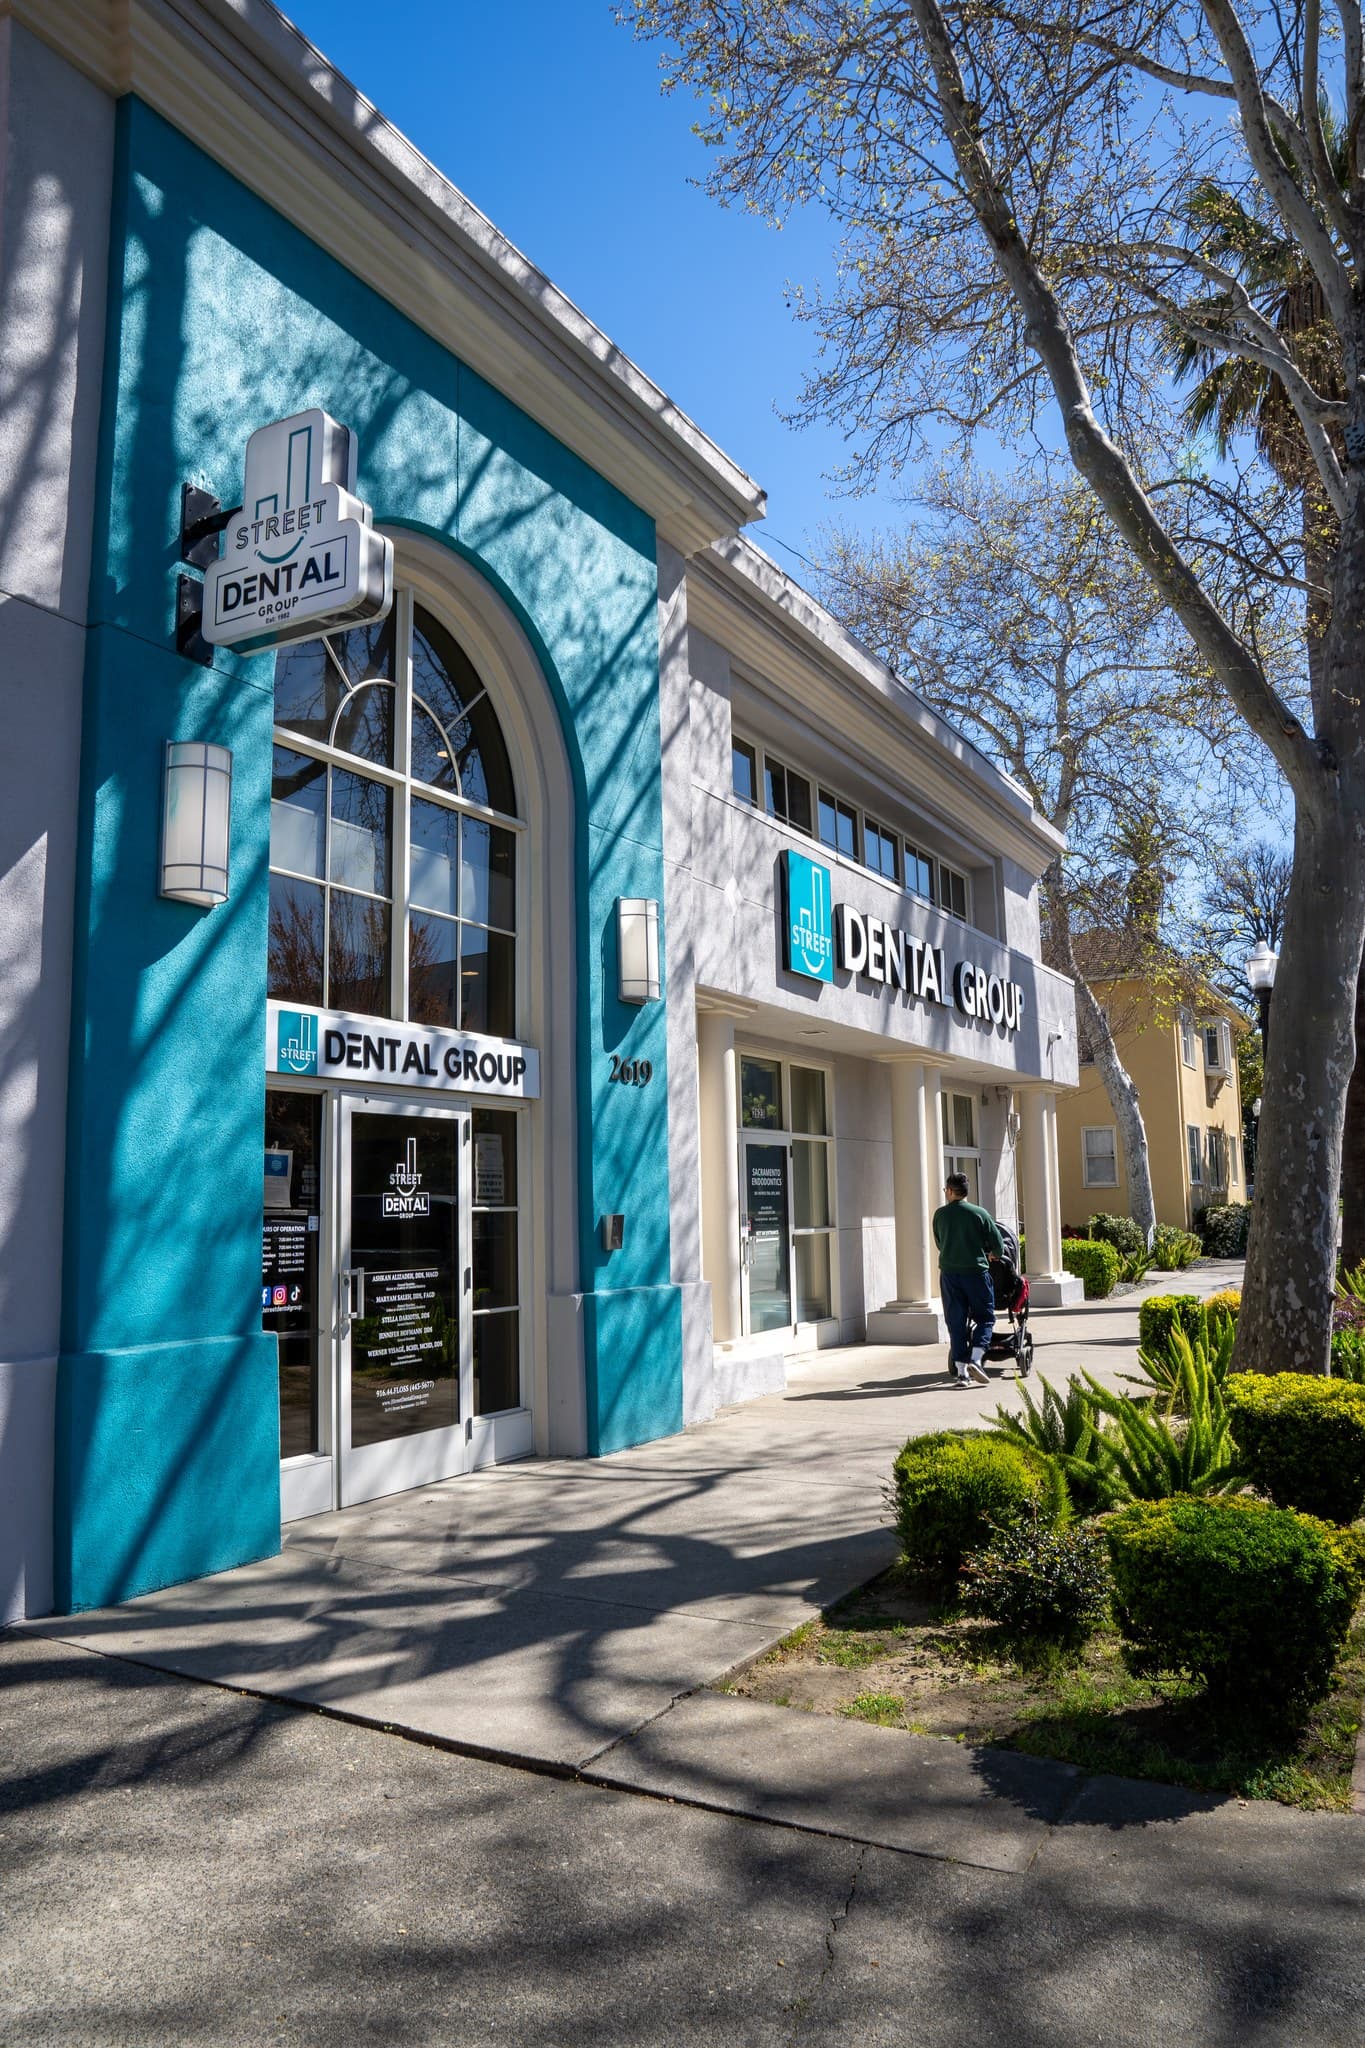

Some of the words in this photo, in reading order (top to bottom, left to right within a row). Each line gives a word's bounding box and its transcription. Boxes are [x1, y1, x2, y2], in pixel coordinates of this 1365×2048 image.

[236, 500, 326, 550] STREET
[222, 552, 339, 612] DENTAL
[258, 596, 299, 617] GROUP
[792, 924, 832, 958] STREET
[837, 903, 953, 1008] DENTAL
[955, 960, 1025, 1032] GROUP
[280, 1047, 316, 1062] STREET
[324, 1030, 438, 1076] DENTAL
[444, 1047, 526, 1086] GROUP
[608, 1054, 653, 1088] 2619
[752, 1168, 781, 1177] SACRAMENTO
[390, 1174, 422, 1184] STREET
[751, 1178, 782, 1186] ENDODONTICS
[386, 1198, 427, 1212] DENTAL
[372, 1274, 392, 1282] ASHKAN
[376, 1295, 397, 1303] MARYAM
[382, 1316, 398, 1324] STELLA
[368, 1348, 388, 1357] WERNER
